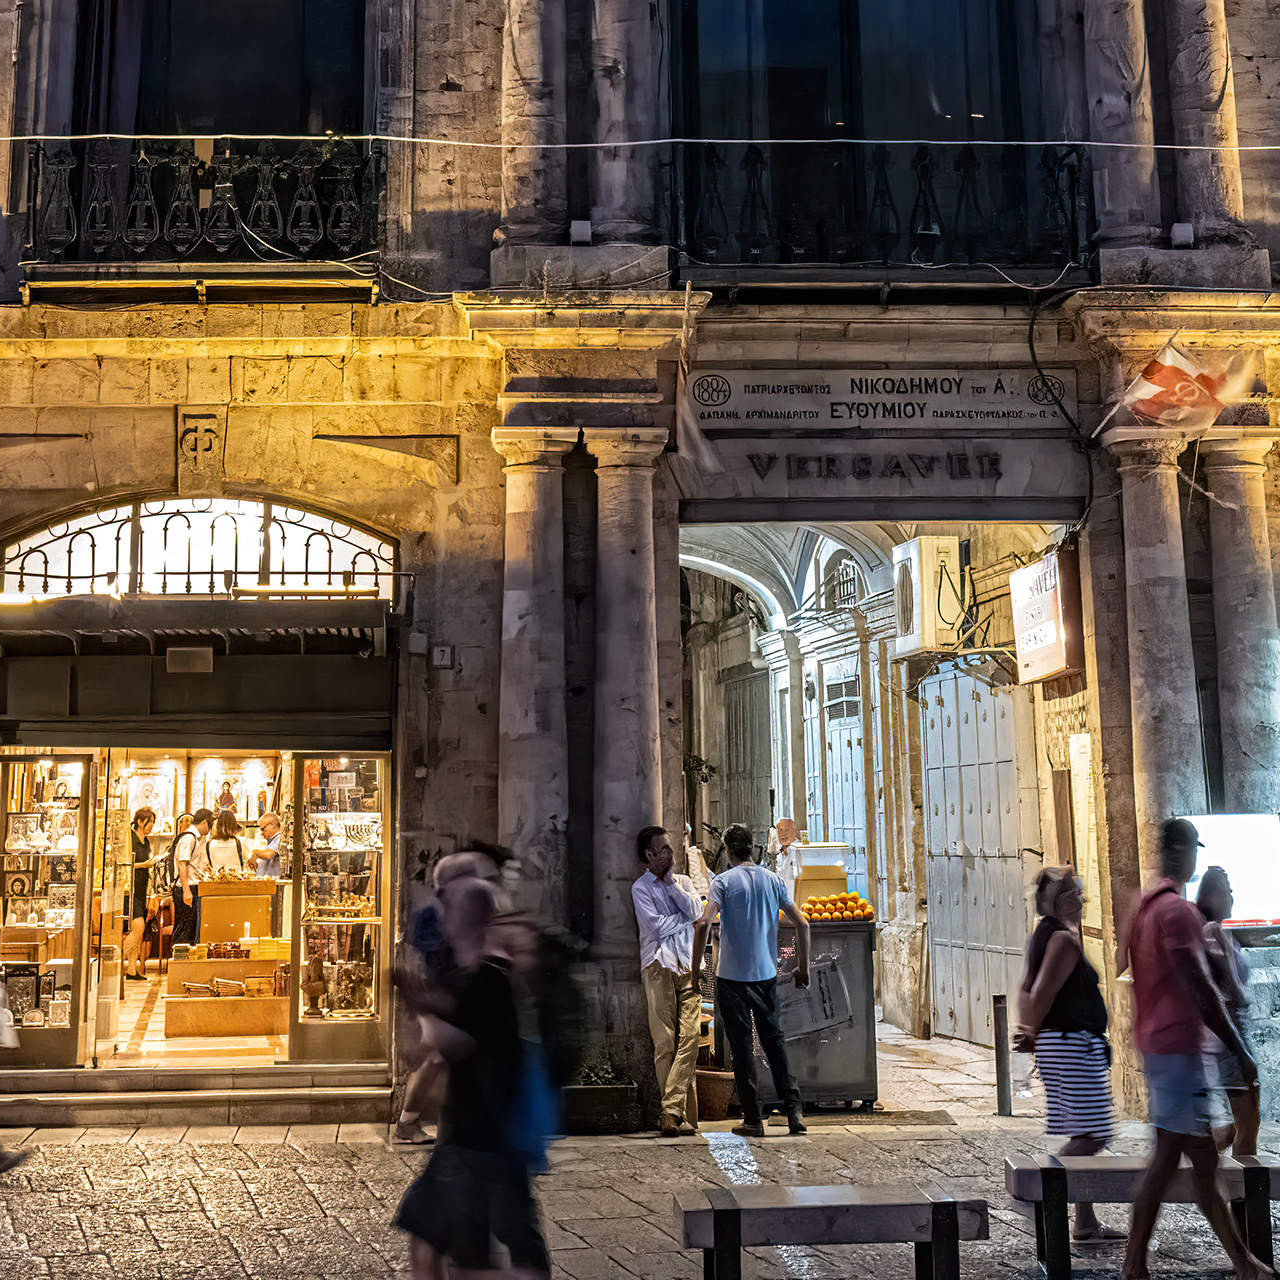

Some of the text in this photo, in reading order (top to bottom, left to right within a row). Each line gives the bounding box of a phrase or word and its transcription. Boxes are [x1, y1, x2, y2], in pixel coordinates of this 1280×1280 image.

[694, 377, 729, 403] 1884
[850, 376, 964, 395] ΝΙΚΟΔΗΜΟΥ
[830, 401, 928, 420] ΕΥΘΥΜΙΟΥ
[439, 649, 446, 662] 7
